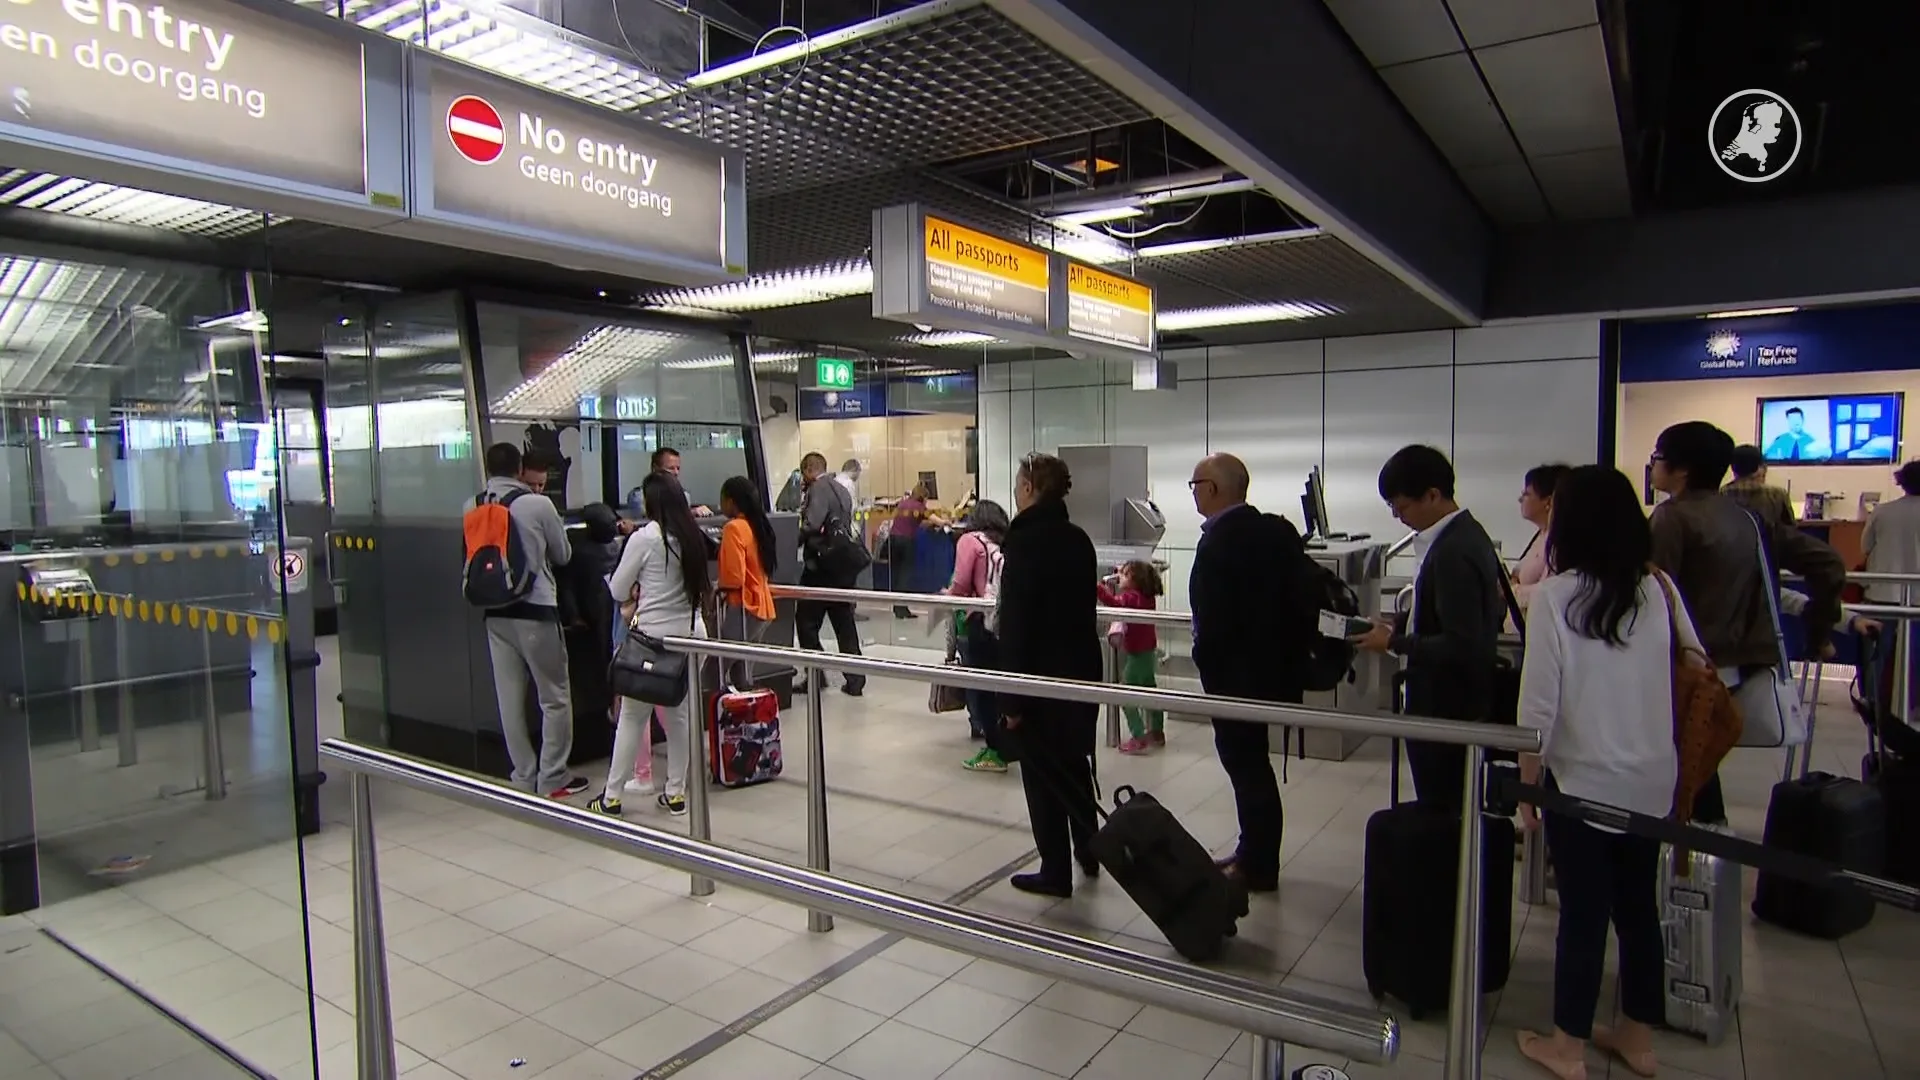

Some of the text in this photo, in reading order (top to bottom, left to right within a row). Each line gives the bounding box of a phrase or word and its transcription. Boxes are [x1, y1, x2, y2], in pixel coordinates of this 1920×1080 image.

[62, 0, 235, 72] entry
[73, 39, 267, 119] doorgang
[518, 112, 657, 187] No entry
[519, 155, 672, 217] Geen doorgang
[930, 228, 1020, 272] All passports
[1069, 266, 1131, 301] All passports
[1700, 359, 1745, 369] Global Blue
[1757, 356, 1797, 367] Refunds
[1758, 345, 1798, 358] Tax Free
